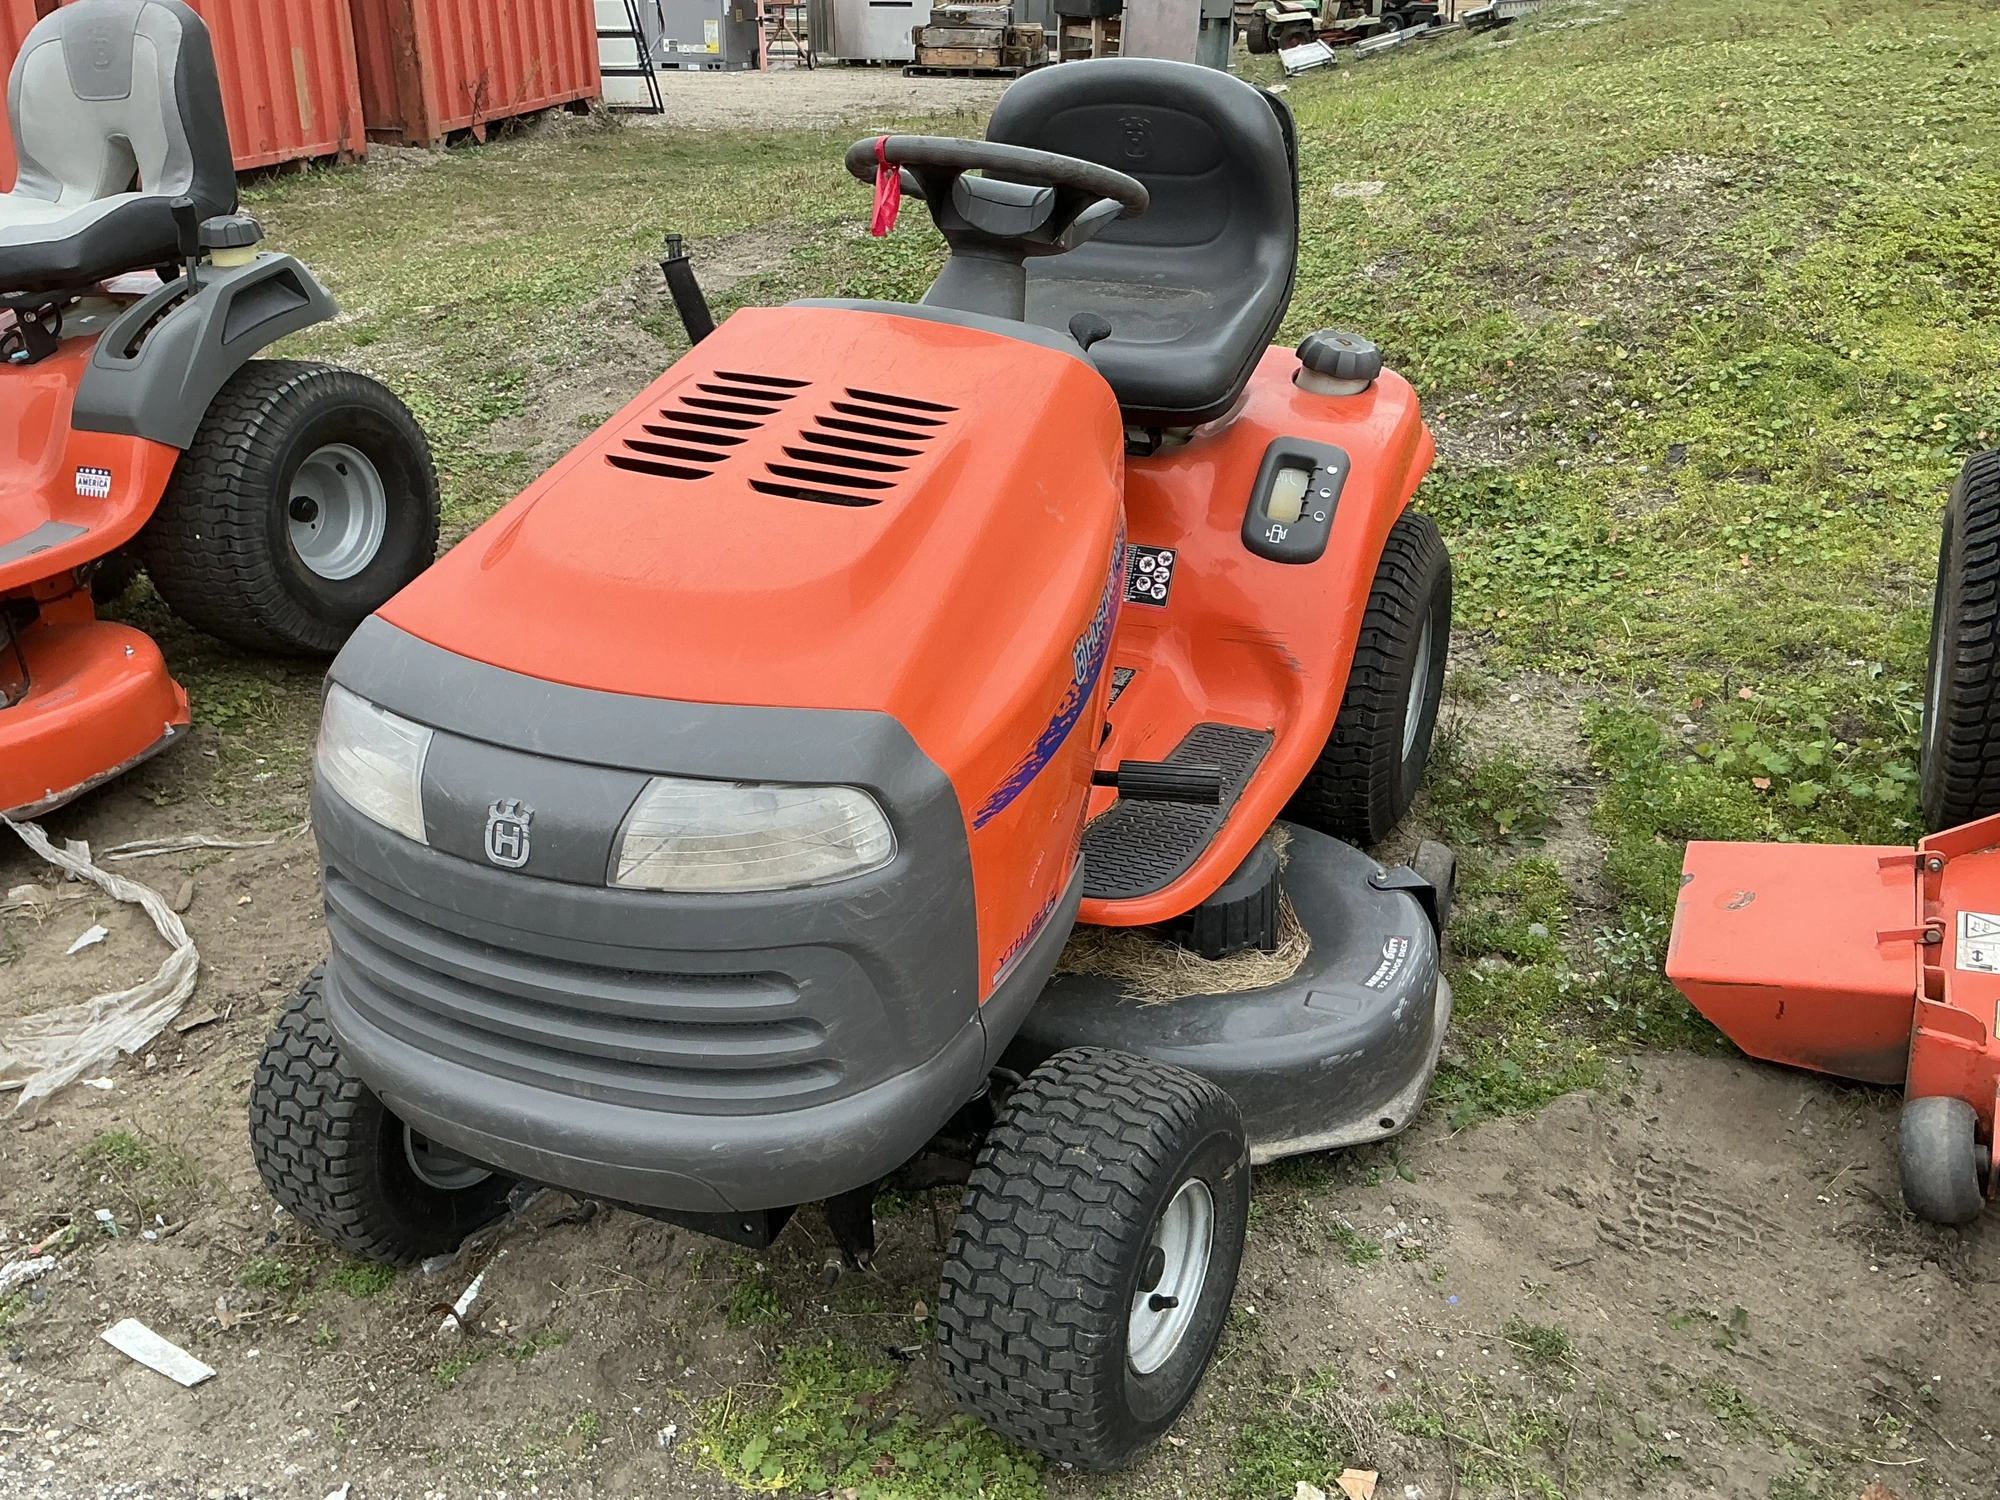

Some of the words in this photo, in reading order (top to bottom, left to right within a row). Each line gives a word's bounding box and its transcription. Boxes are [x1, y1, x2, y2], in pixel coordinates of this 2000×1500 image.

[78, 477, 108, 488] AMERICA
[1364, 959, 1392, 988] HEAVY
[1386, 937, 1399, 960] DUTY
[1377, 980, 1389, 989] 12
[1385, 958, 1404, 981] GAUGE
[1398, 939, 1409, 958] DECK
